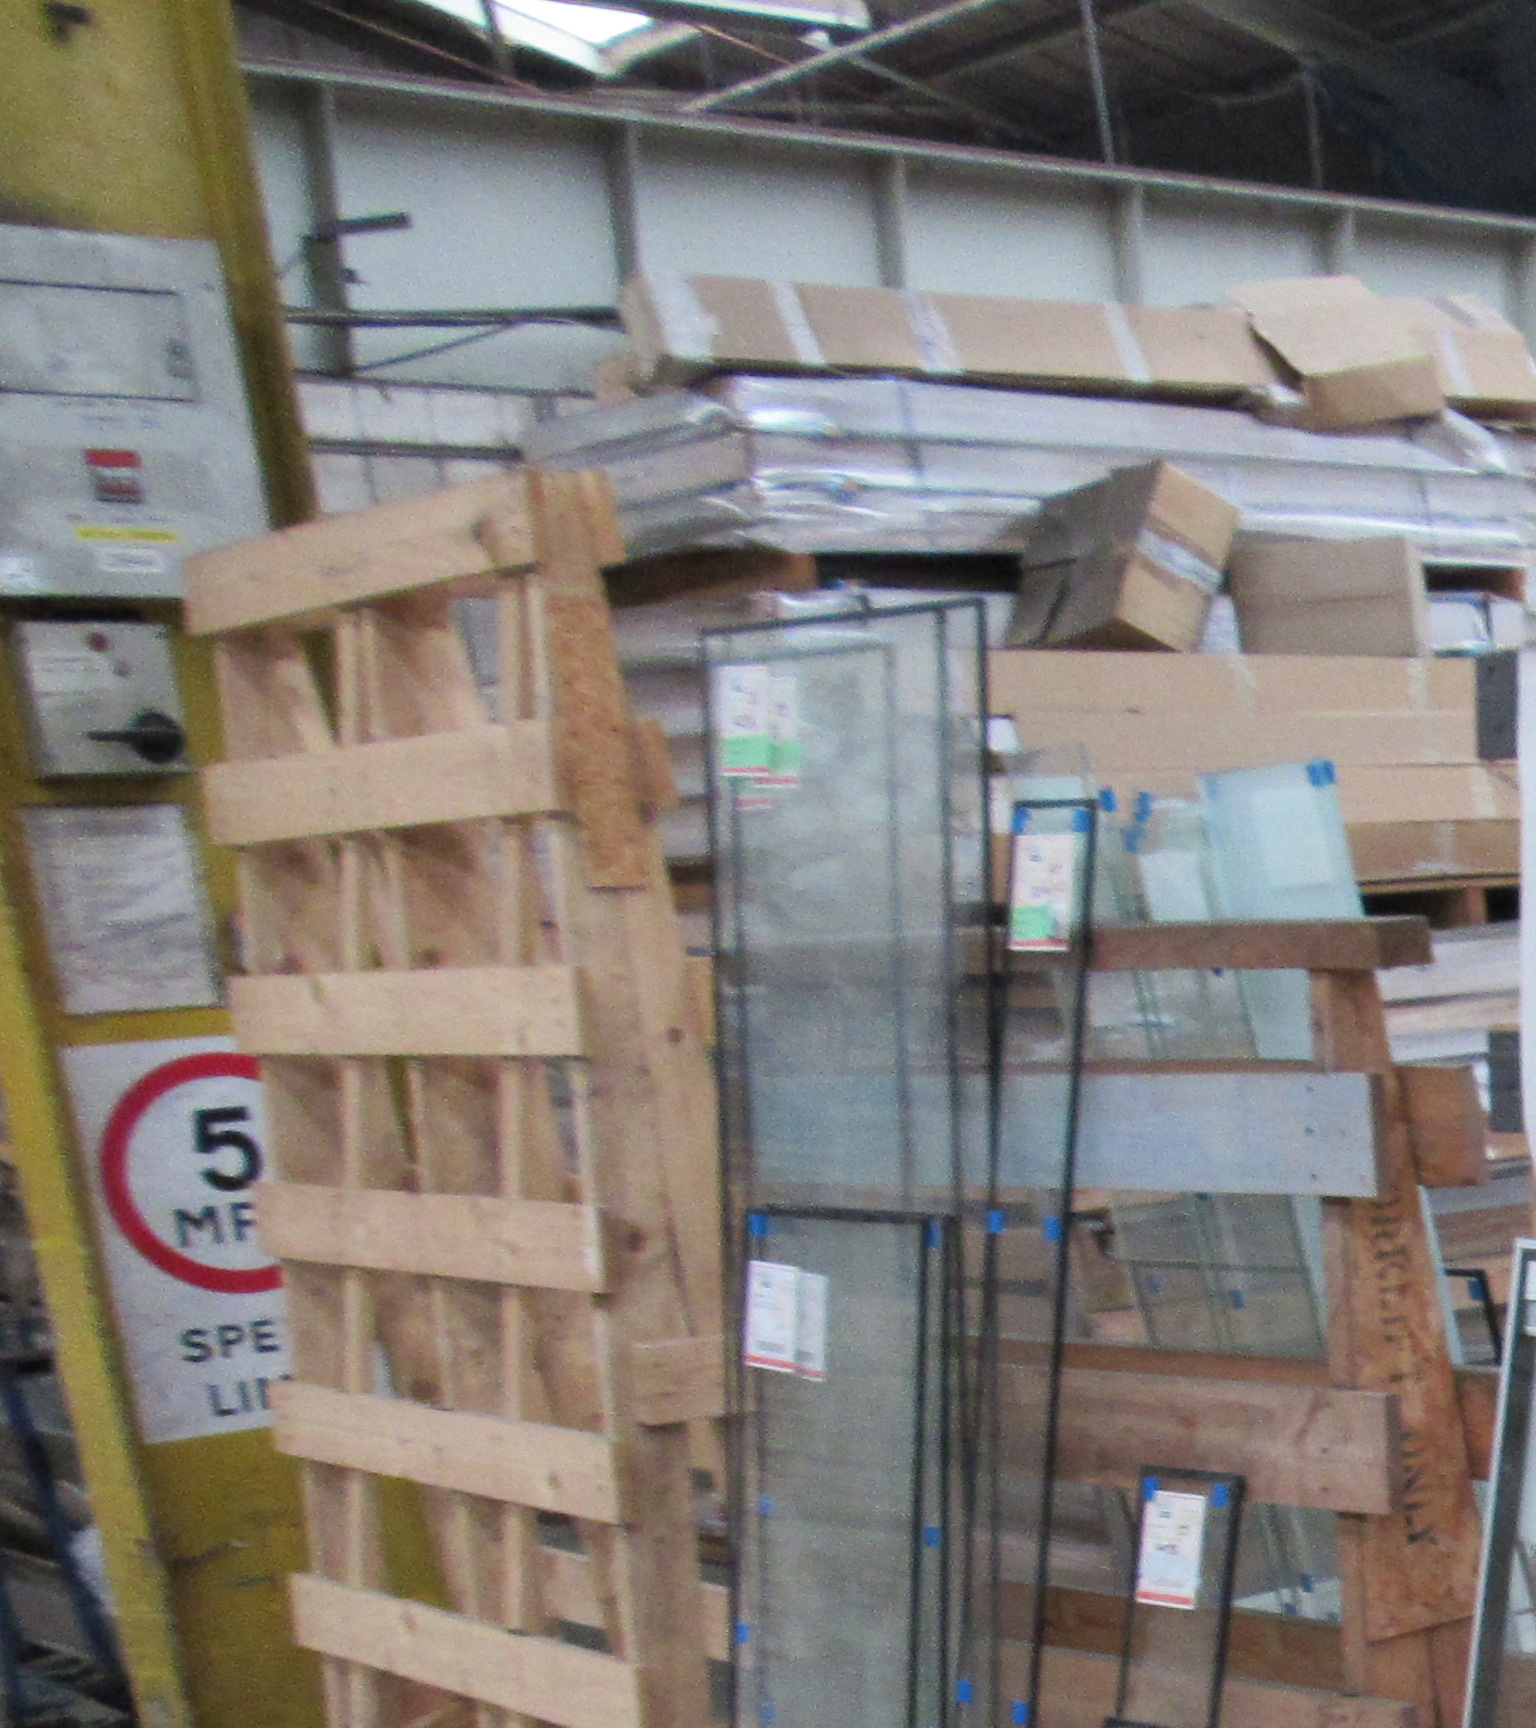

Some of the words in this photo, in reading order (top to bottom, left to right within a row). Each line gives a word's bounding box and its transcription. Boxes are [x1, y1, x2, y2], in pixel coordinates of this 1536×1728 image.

[193, 1105, 264, 1191] 5
[173, 1202, 256, 1247] MP
[180, 1319, 281, 1362] SPE
